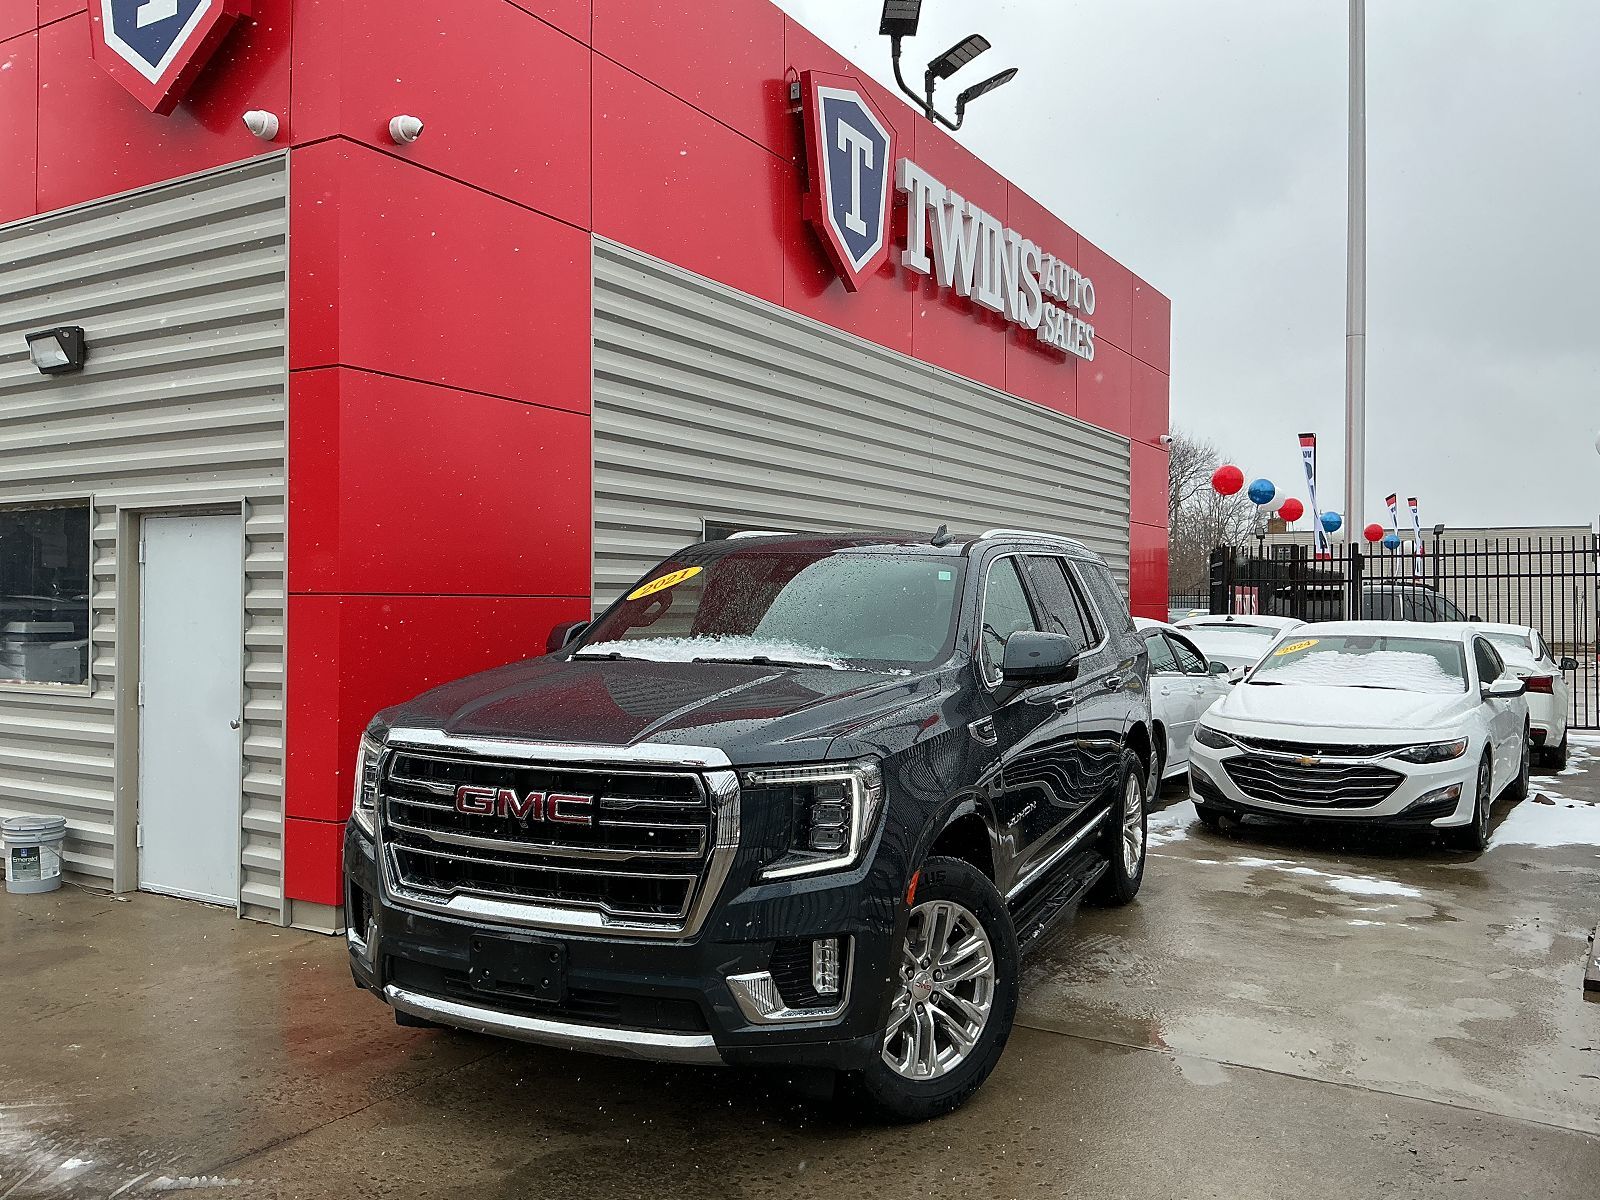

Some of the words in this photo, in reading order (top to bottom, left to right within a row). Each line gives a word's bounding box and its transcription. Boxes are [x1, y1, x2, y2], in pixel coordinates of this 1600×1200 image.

[837, 118, 873, 237] T
[896, 157, 1042, 329] TWINS
[1042, 253, 1096, 315] AUTO
[1038, 302, 1095, 361] SALES
[640, 569, 689, 596] 2021
[1281, 641, 1311, 653] 2024
[456, 785, 593, 825] GMC
